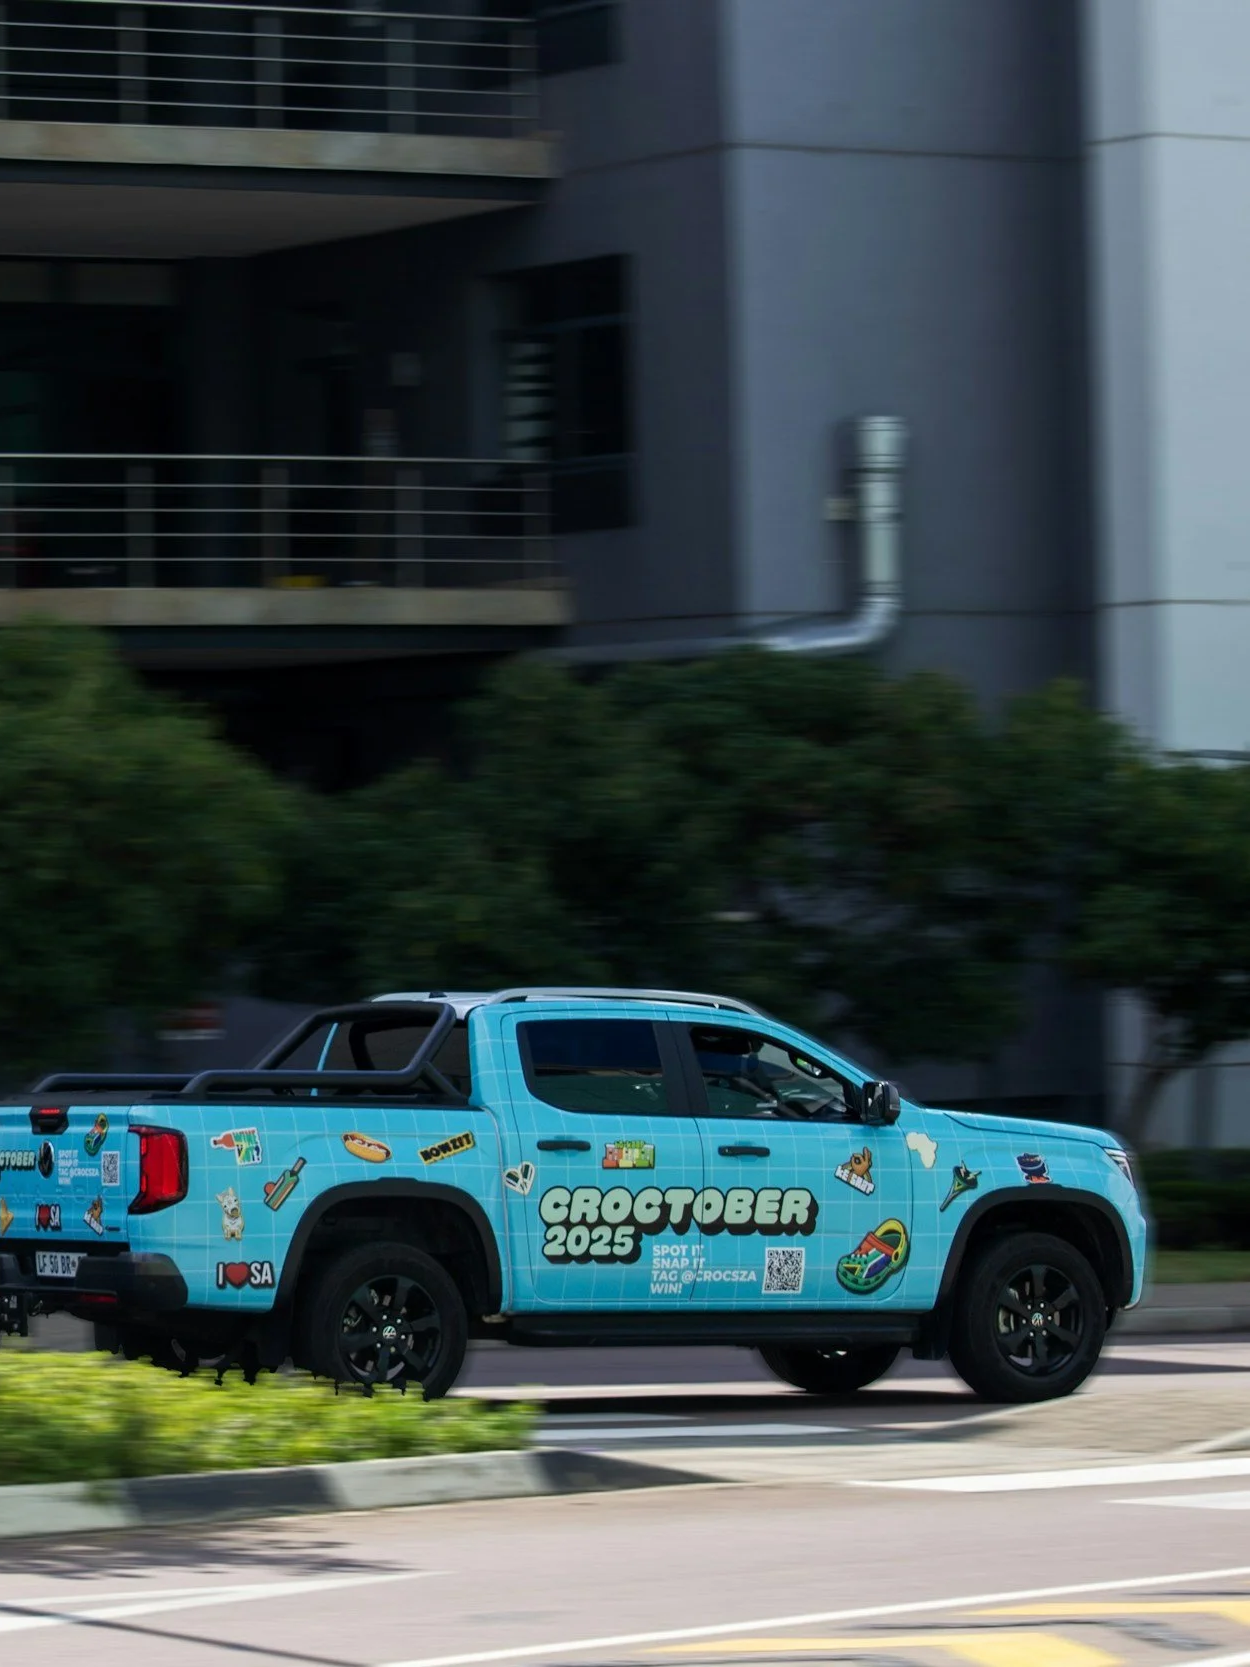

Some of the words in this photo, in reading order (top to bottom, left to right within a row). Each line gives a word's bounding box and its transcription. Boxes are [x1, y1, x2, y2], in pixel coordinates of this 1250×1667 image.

[50, 1204, 61, 1228] SA
[539, 1186, 815, 1230] CROCTOBER
[541, 1225, 638, 1259] 2025
[652, 1245, 688, 1257] SPOT
[691, 1245, 705, 1257] IT
[652, 1257, 689, 1269] SNAP
[693, 1257, 706, 1269] IT
[250, 1262, 273, 1285] SA
[651, 1270, 678, 1281] TAG
[681, 1270, 757, 1284] @CROCSZA
[650, 1282, 682, 1294] WIN!
